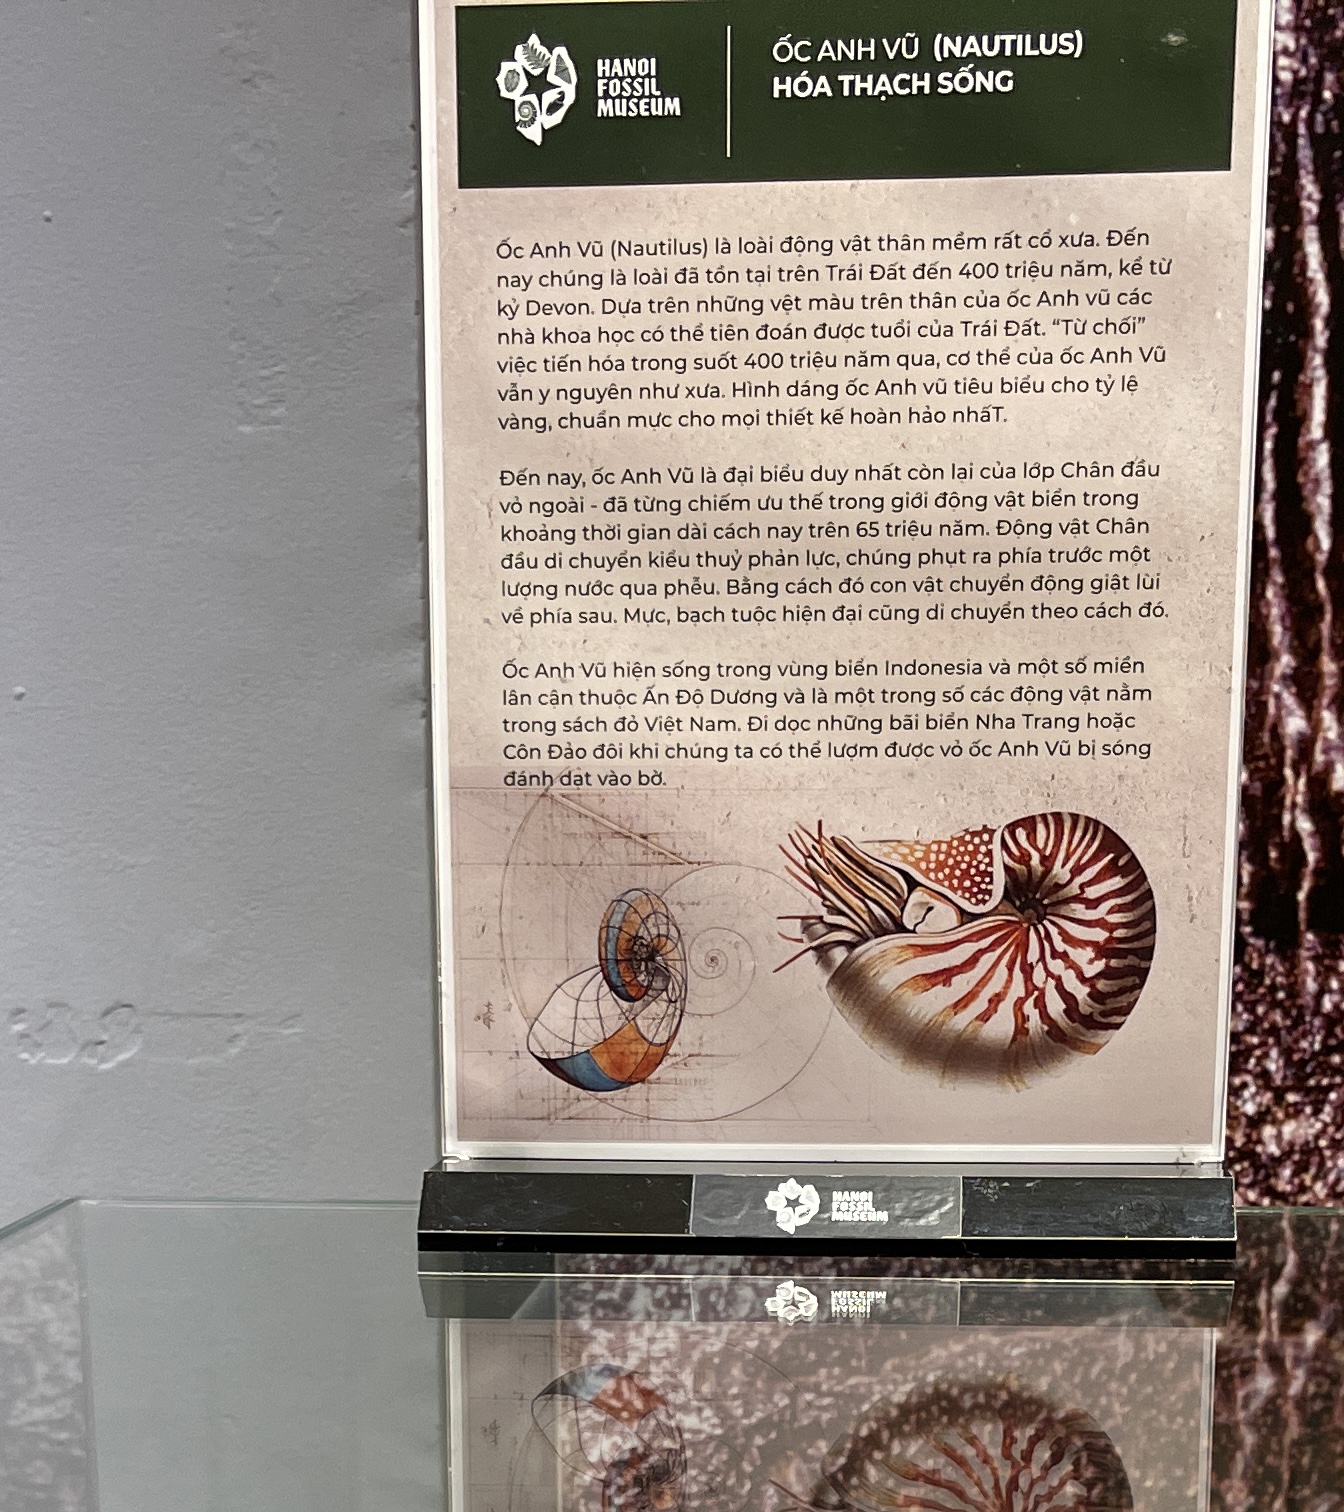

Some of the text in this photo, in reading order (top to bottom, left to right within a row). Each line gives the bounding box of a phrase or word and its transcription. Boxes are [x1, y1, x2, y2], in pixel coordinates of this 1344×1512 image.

[772, 29, 1083, 62] ỐC ANH VŨ (NAUTILUS)
[596, 57, 657, 77] HANOI
[597, 77, 662, 98] FOSSIL
[772, 63, 1014, 101] HÓA THẠCH SỐNG
[596, 97, 681, 118] MUSEUM
[495, 236, 525, 260] Ốc
[529, 240, 571, 259] Anh
[576, 240, 604, 258] Vũ
[610, 237, 708, 262] (Nautilus)
[715, 236, 732, 255] là
[738, 235, 774, 255] loài
[779, 235, 834, 258] động
[839, 234, 873, 257] vật
[876, 233, 926, 252] thân
[993, 229, 1023, 250] rất
[1027, 227, 1053, 249] cổ
[1057, 230, 1101, 249] xưa.
[1105, 226, 1150, 247] Đến
[497, 286, 1153, 321] kỷ Devon. Dựa trên những vệt màu trên thân của ốc Anh vũ các
[497, 315, 1146, 348] nhà khoa học có thể tiên đoán được tuổi của Trái Đất. “Từ chối”
[496, 344, 1166, 378] việc tiến hóa trong suốt 400 triệu năm qua, cơ thể của ốc Anh Vũ
[498, 466, 541, 487] Đến
[547, 472, 587, 490] nay,
[589, 466, 616, 486] ốc
[620, 466, 662, 485] Anh
[666, 466, 694, 484] Vũ
[700, 465, 717, 484] là
[722, 464, 754, 488] đại
[760, 462, 805, 483] biểu
[810, 464, 850, 486] duy
[854, 461, 903, 482] nhất
[907, 462, 945, 481] còn
[951, 461, 974, 484] lại
[979, 460, 1016, 480] của
[1023, 461, 1055, 483] lớp
[1060, 460, 1115, 479] Chân
[500, 516, 1150, 546] khoảng thời gian dài cách nay trên 65 triệu năm. Động vật Chân
[529, 606, 573, 629] phía
[578, 610, 618, 624] sau.
[623, 607, 671, 628] Mực,
[676, 605, 725, 628] bạch
[730, 605, 777, 627] tuộc
[782, 604, 826, 627] hiện
[831, 603, 863, 626] đại
[868, 603, 920, 625] cũng
[925, 602, 945, 621] di
[950, 600, 1025, 624] chuyển
[1030, 601, 1079, 620] theo
[1083, 600, 1132, 619] cách
[1138, 600, 1169, 619] đó.
[502, 681, 1152, 710] lân cận thuộc Ấn Độ Dương và là một trong số các động vật nằm
[501, 711, 1137, 737] trong sách đỏ Việt Nam. Đi dọc những bãi biển Nha Trang hoặc
[503, 767, 668, 791] đánh dạt vào bờ.
[831, 1201, 876, 1212] FOSSIL
[831, 1210, 889, 1222] MUSEUM
